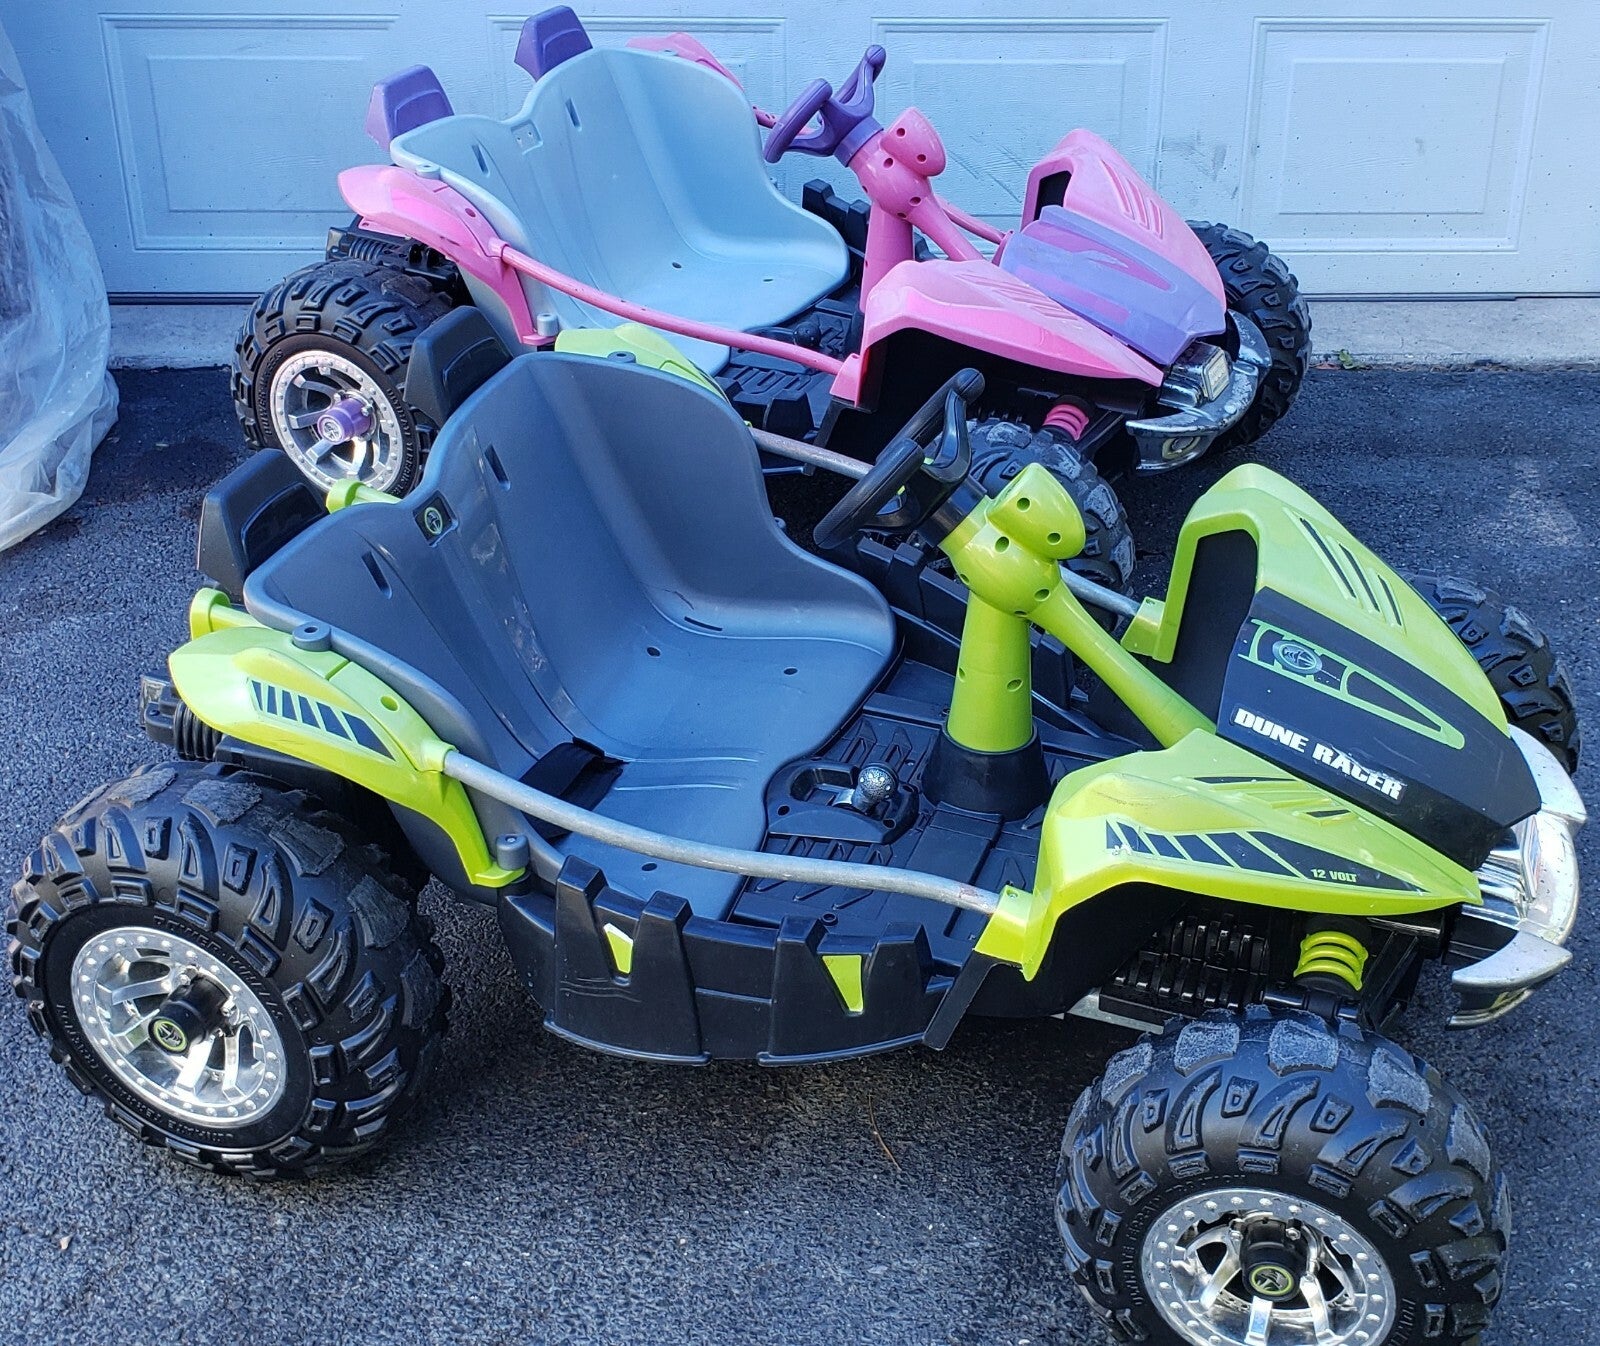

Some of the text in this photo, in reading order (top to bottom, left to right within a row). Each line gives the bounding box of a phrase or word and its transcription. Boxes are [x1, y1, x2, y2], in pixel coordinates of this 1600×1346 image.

[1233, 708, 1404, 800] DUNE RACER
[1310, 868, 1357, 883] 12 VOLT
